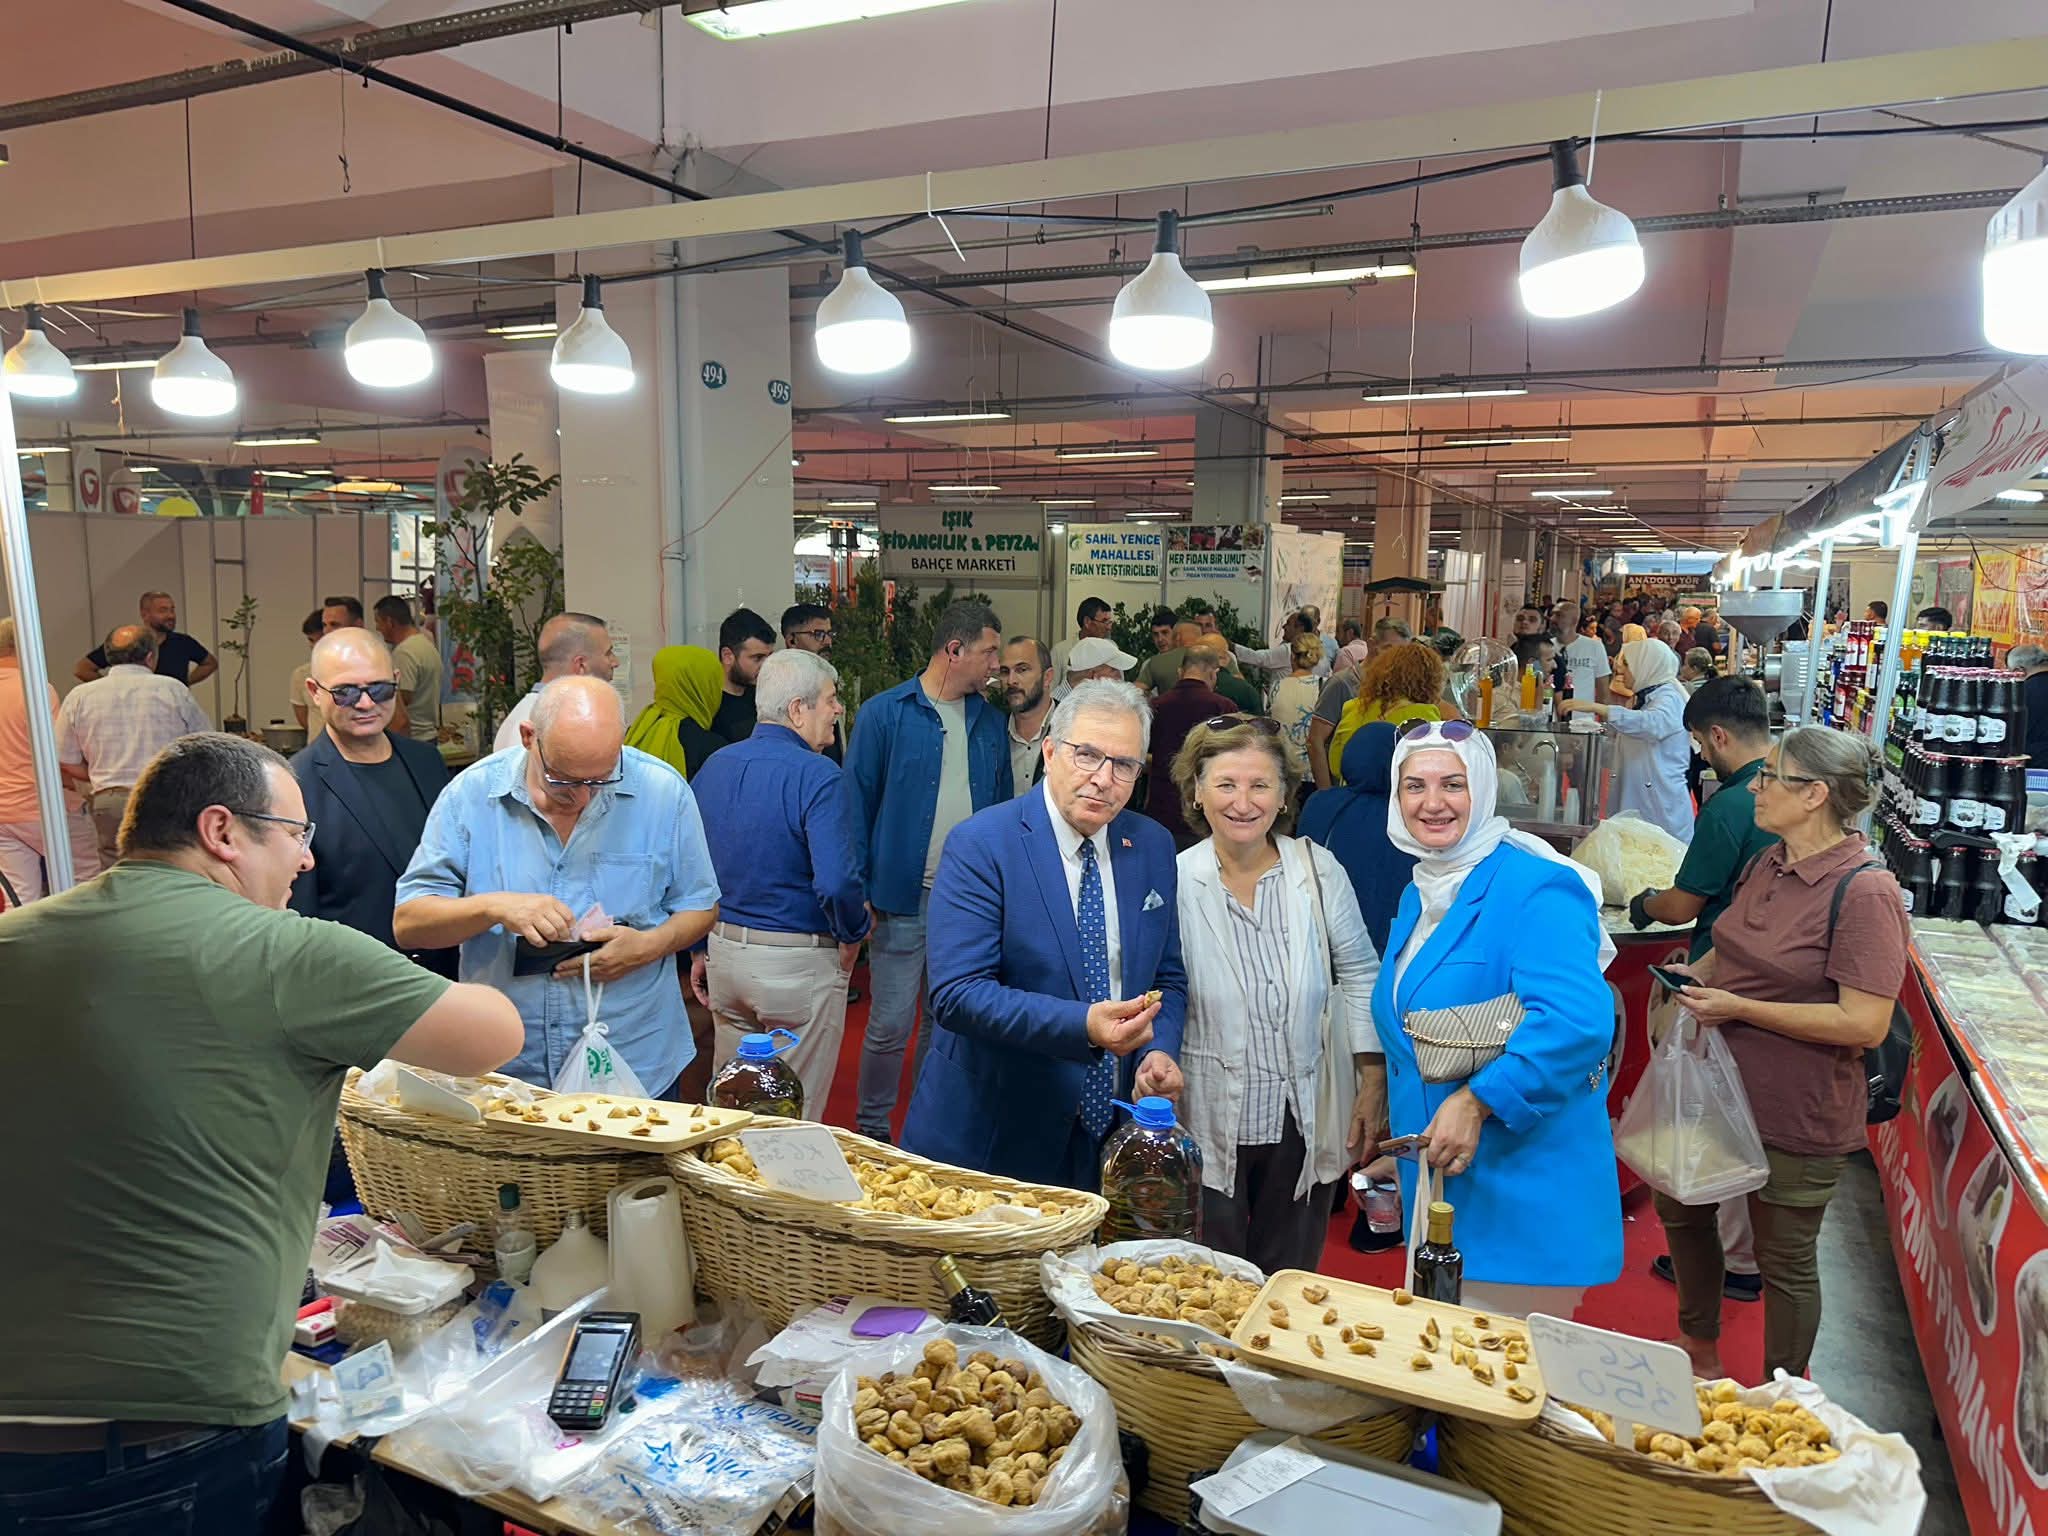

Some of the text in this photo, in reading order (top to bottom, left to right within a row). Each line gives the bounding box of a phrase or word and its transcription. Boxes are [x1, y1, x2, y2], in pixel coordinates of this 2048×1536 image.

[703, 365, 724, 384] 494
[771, 381, 790, 401] 495
[942, 510, 974, 531] IŞIK
[882, 530, 967, 552] FİDANCILIK
[1085, 533, 1118, 545] SAHİL
[1090, 550, 1154, 561] MAHALLESİ
[1168, 554, 1246, 565] HER FİDAN BİR UMUT
[911, 556, 1016, 573] BAHÇE MARKETİ
[1070, 563, 1094, 576] FİDAN
[1628, 576, 1677, 584] ANADOLU
[1936, 1264, 2035, 1536] PİŞMANİY
